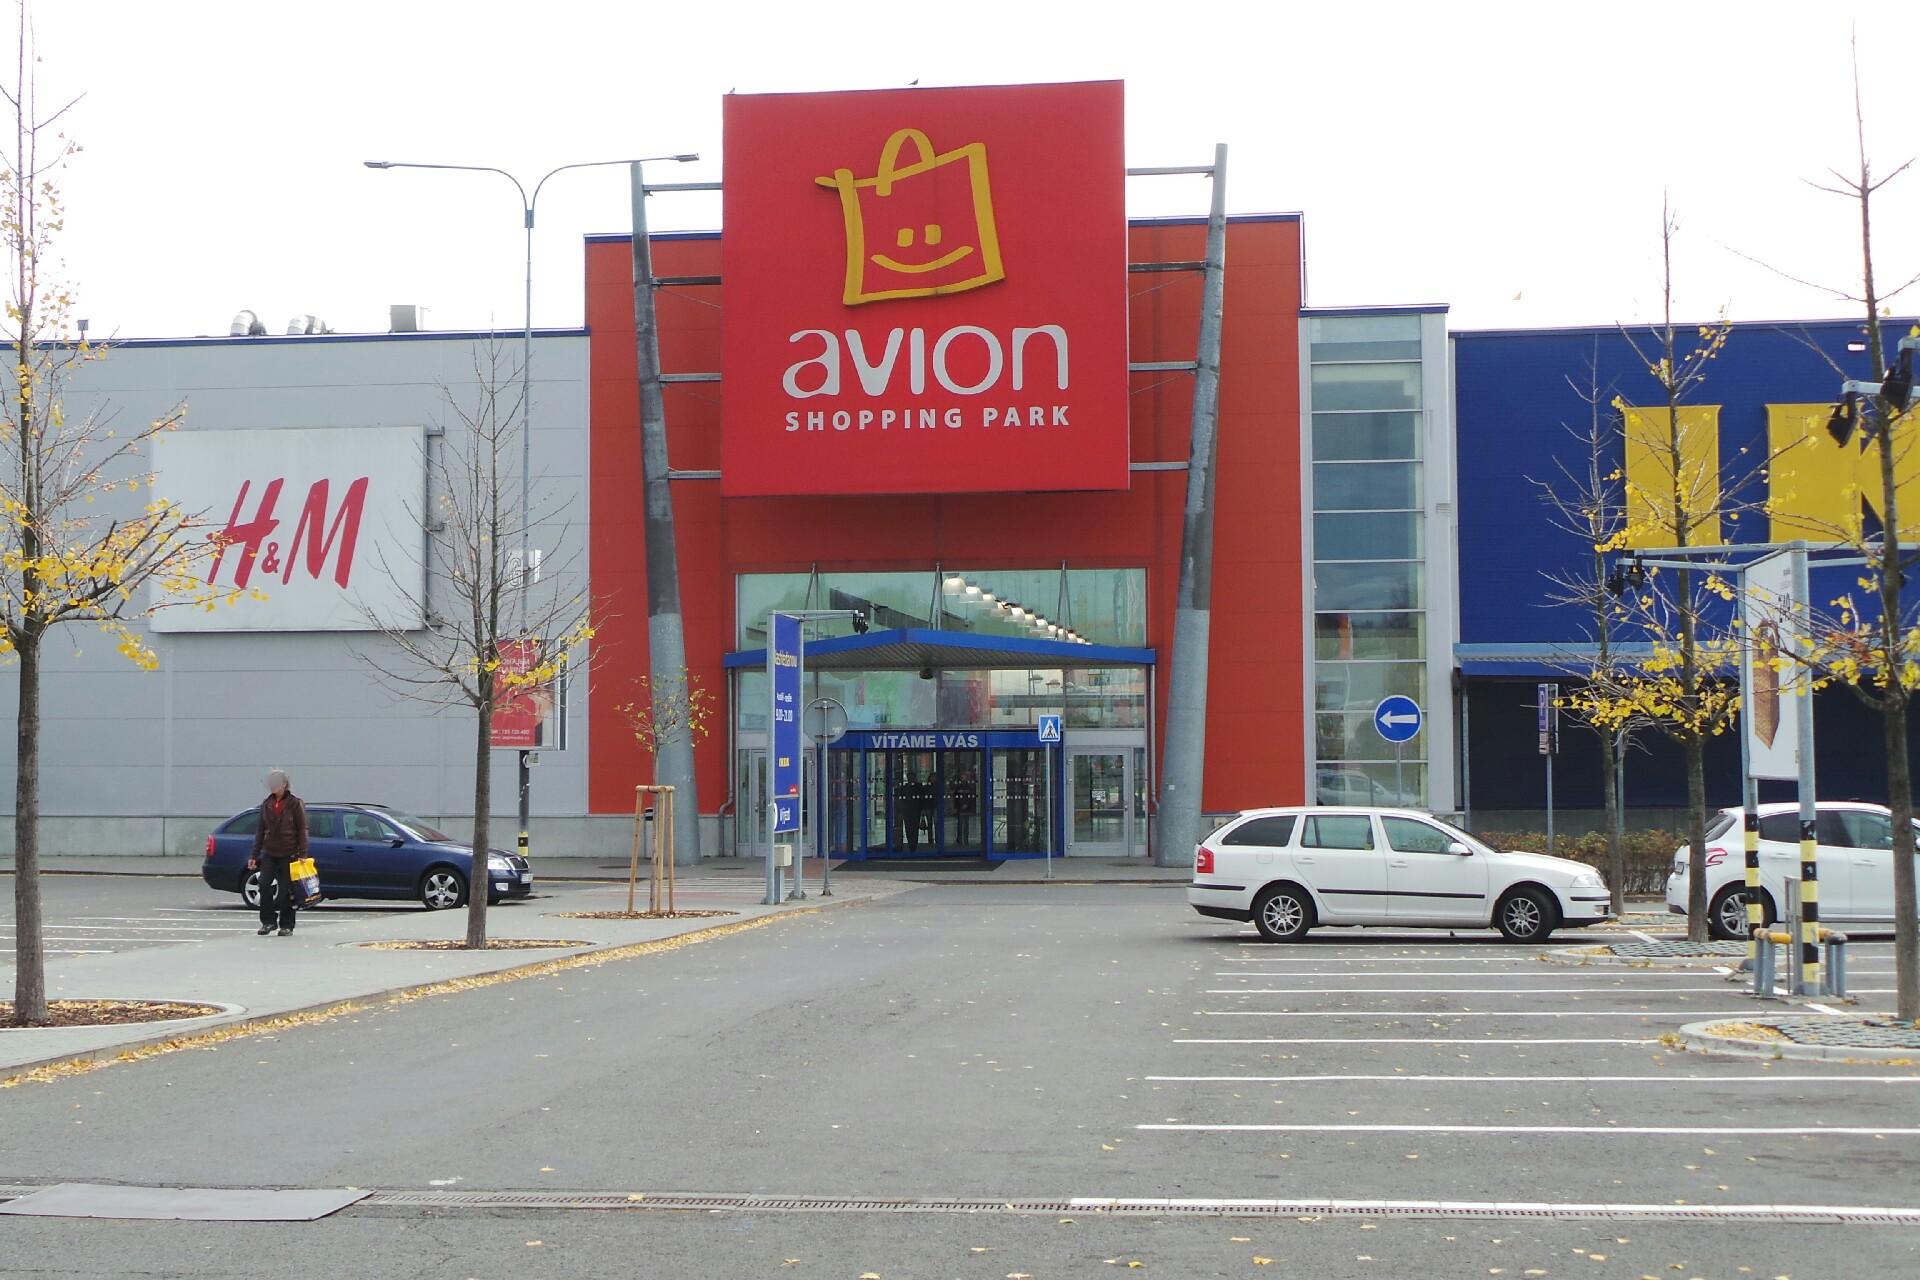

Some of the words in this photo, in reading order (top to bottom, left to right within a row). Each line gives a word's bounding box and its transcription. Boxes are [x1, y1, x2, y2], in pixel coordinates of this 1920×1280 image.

[782, 324, 1069, 398] avion
[785, 407, 963, 431] SHOPPING
[983, 405, 1070, 427] PARK
[206, 476, 369, 590] H&M
[872, 732, 936, 749] VÍTÁME
[943, 732, 978, 748] VÁS
